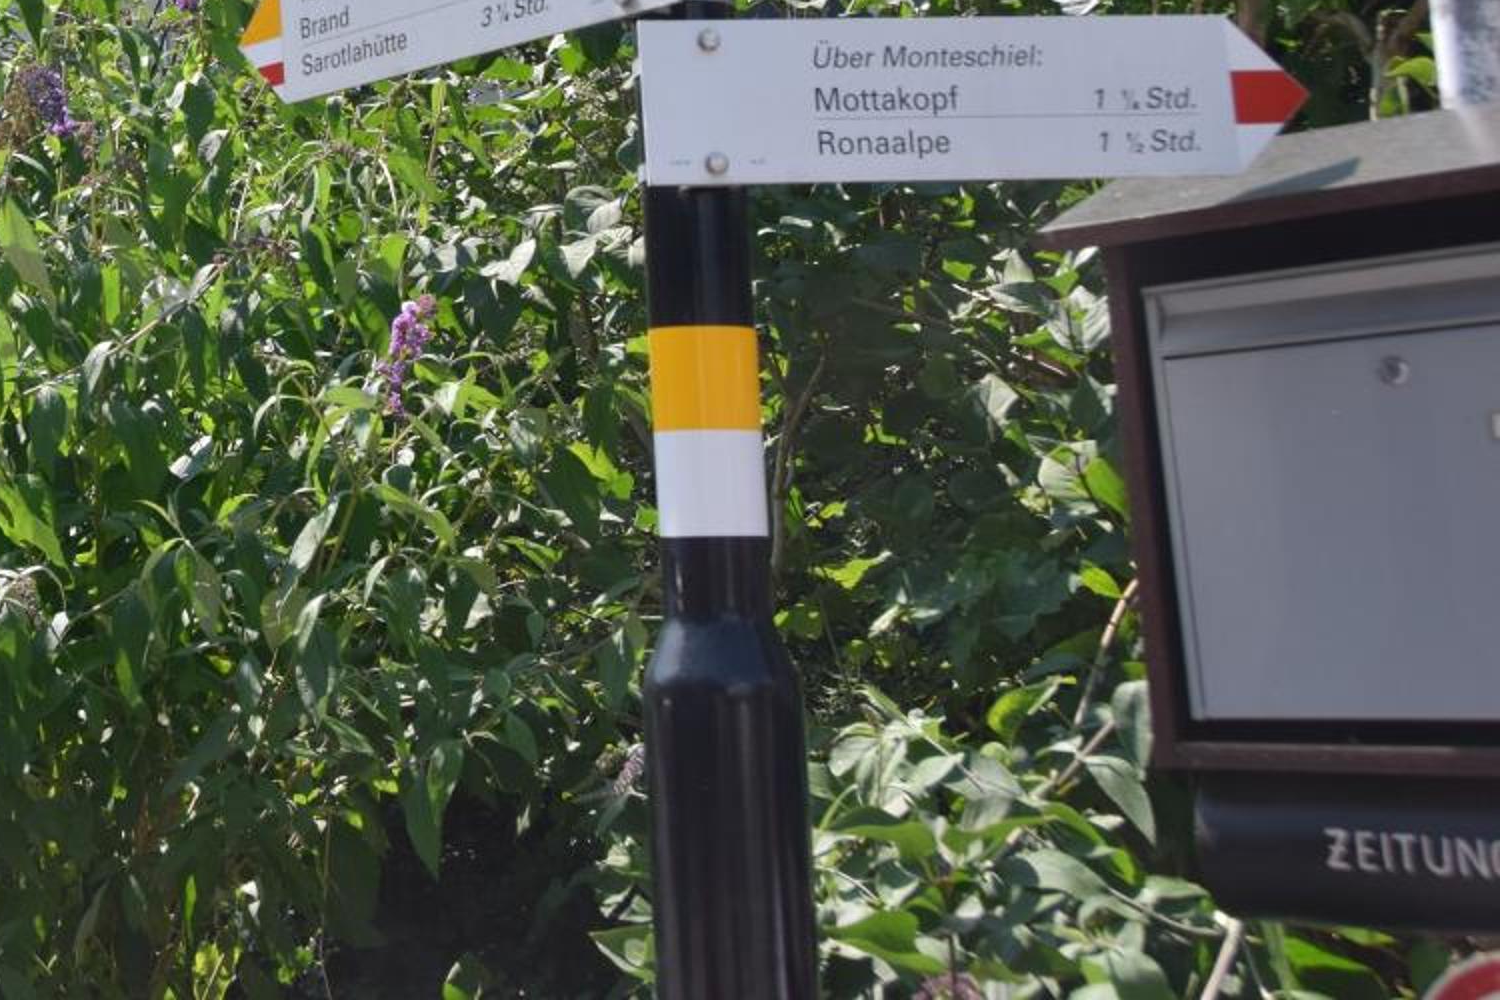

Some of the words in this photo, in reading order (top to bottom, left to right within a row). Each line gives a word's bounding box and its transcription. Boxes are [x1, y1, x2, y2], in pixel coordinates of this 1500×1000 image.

[300, 4, 350, 39] Brand
[301, 32, 407, 76] Sarotlahütte
[481, 5, 493, 28] 3
[812, 40, 874, 69] Über
[882, 45, 1043, 68] Monteschiel:
[814, 85, 958, 116] Mottakopf
[1094, 87, 1105, 110] 1
[1146, 85, 1198, 110] Std.
[817, 129, 951, 159] Ronaalpe
[1100, 131, 1109, 152] 1
[1150, 129, 1202, 153] Std.
